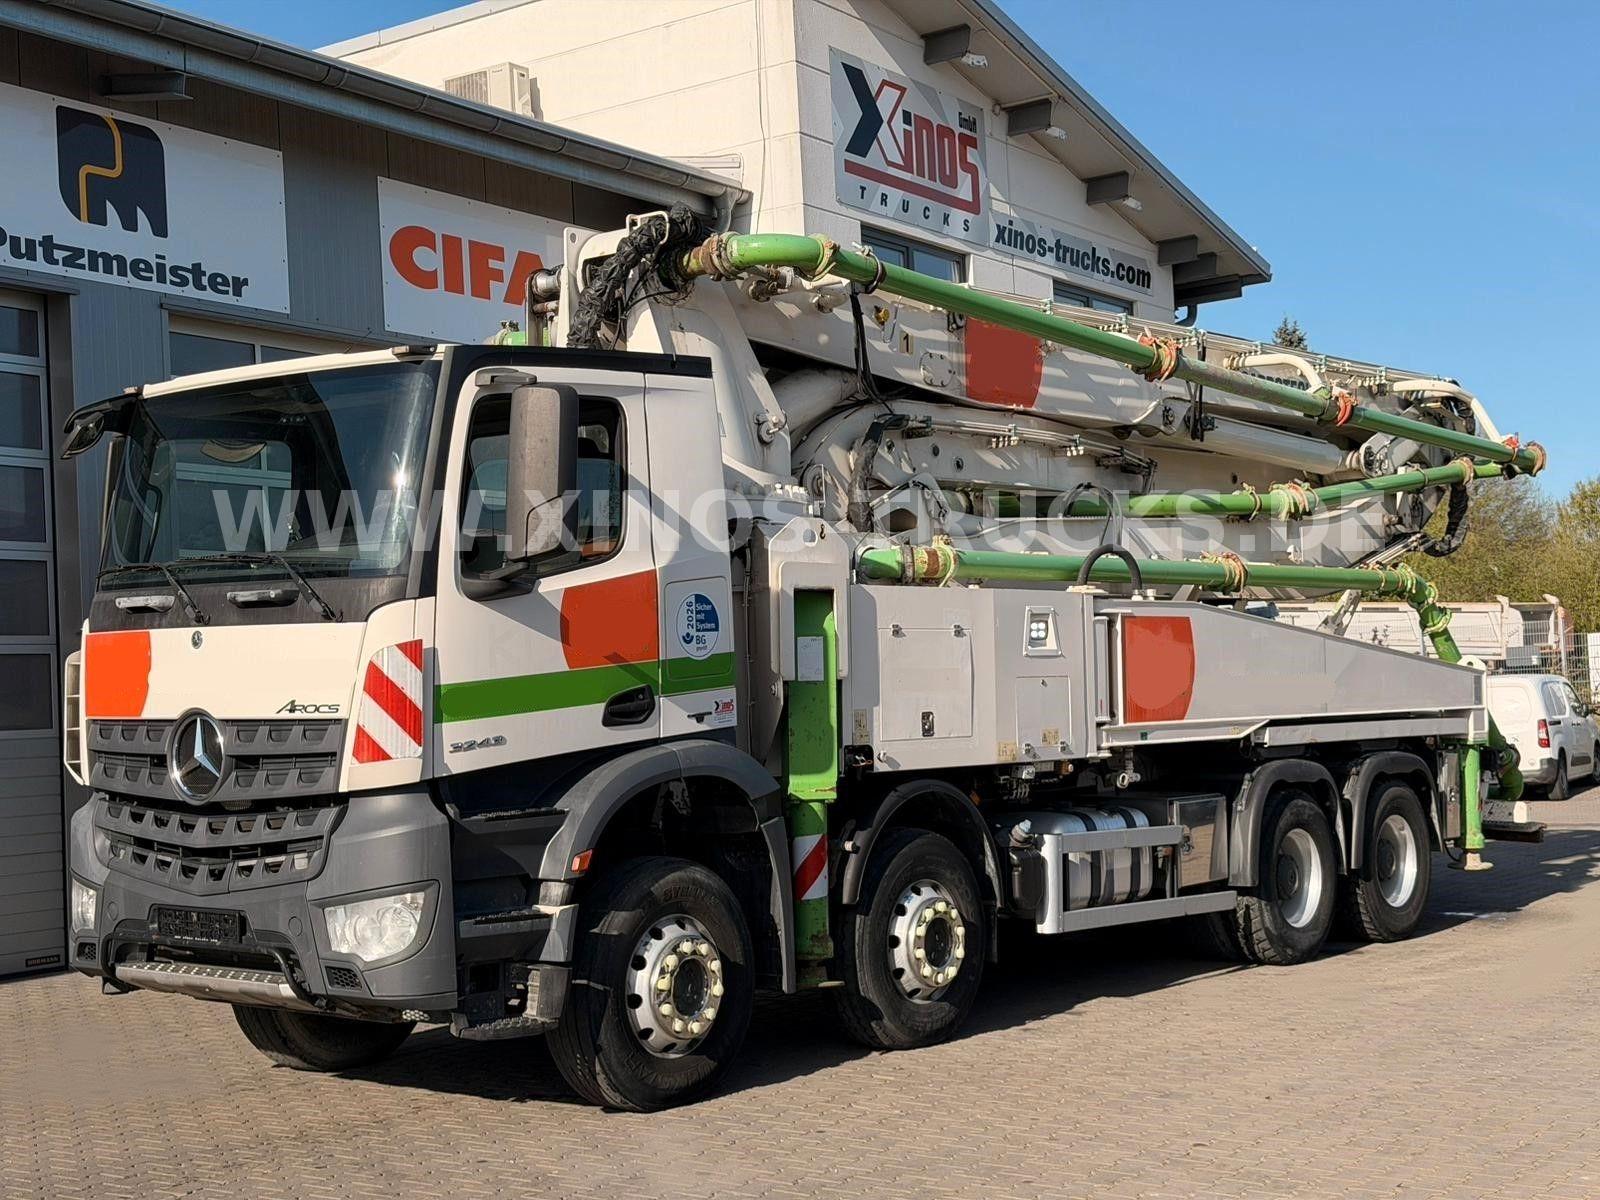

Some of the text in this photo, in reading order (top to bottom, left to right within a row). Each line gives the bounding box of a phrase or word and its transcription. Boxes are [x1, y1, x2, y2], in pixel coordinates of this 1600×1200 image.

[858, 184, 971, 233] TRUCKS
[0, 226, 249, 298] utzmeister
[389, 225, 545, 306] CIFA
[994, 219, 1152, 290] xinos-trucks.com
[686, 601, 695, 630] 2026
[695, 634, 707, 645] BG
[696, 621, 716, 630] System
